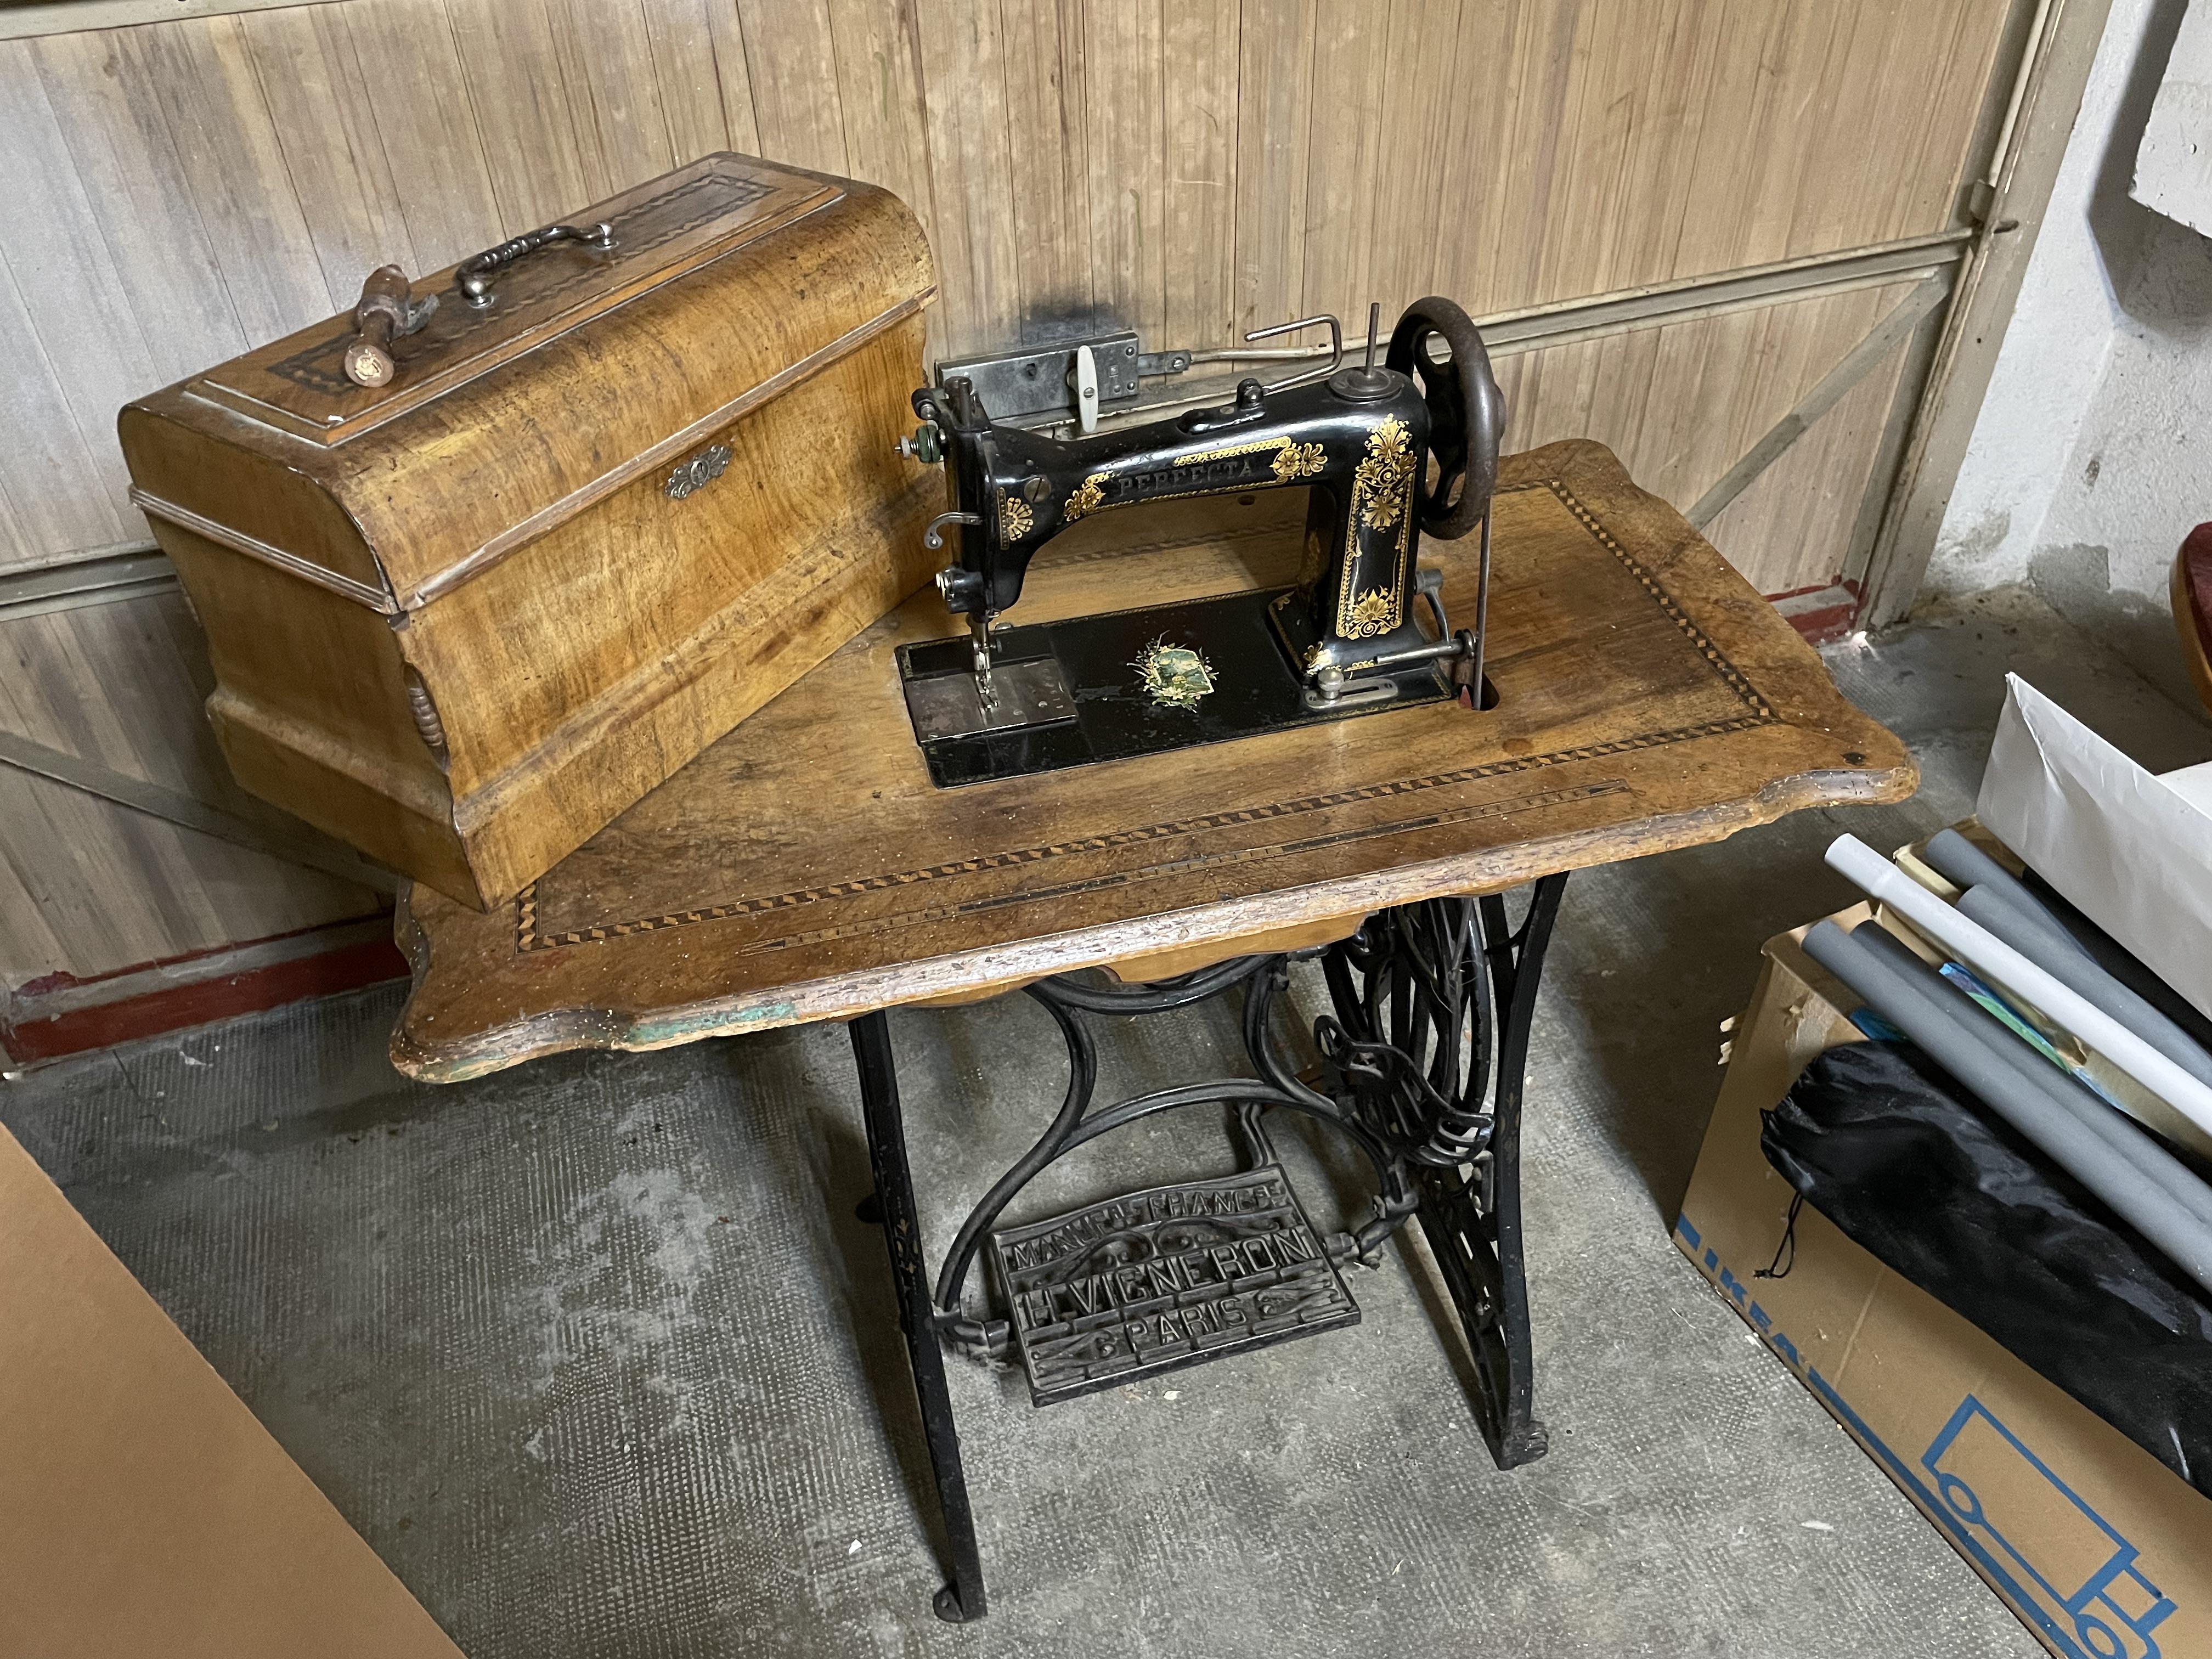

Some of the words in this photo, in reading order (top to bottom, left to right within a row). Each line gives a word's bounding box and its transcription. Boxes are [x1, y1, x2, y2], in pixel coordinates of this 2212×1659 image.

[1118, 458, 1252, 497] PERFECTA
[1069, 1228, 1318, 1314] VIGNERON
[1125, 1296, 1248, 1352] PARIS
[1703, 1247, 1801, 1367] IKEA
